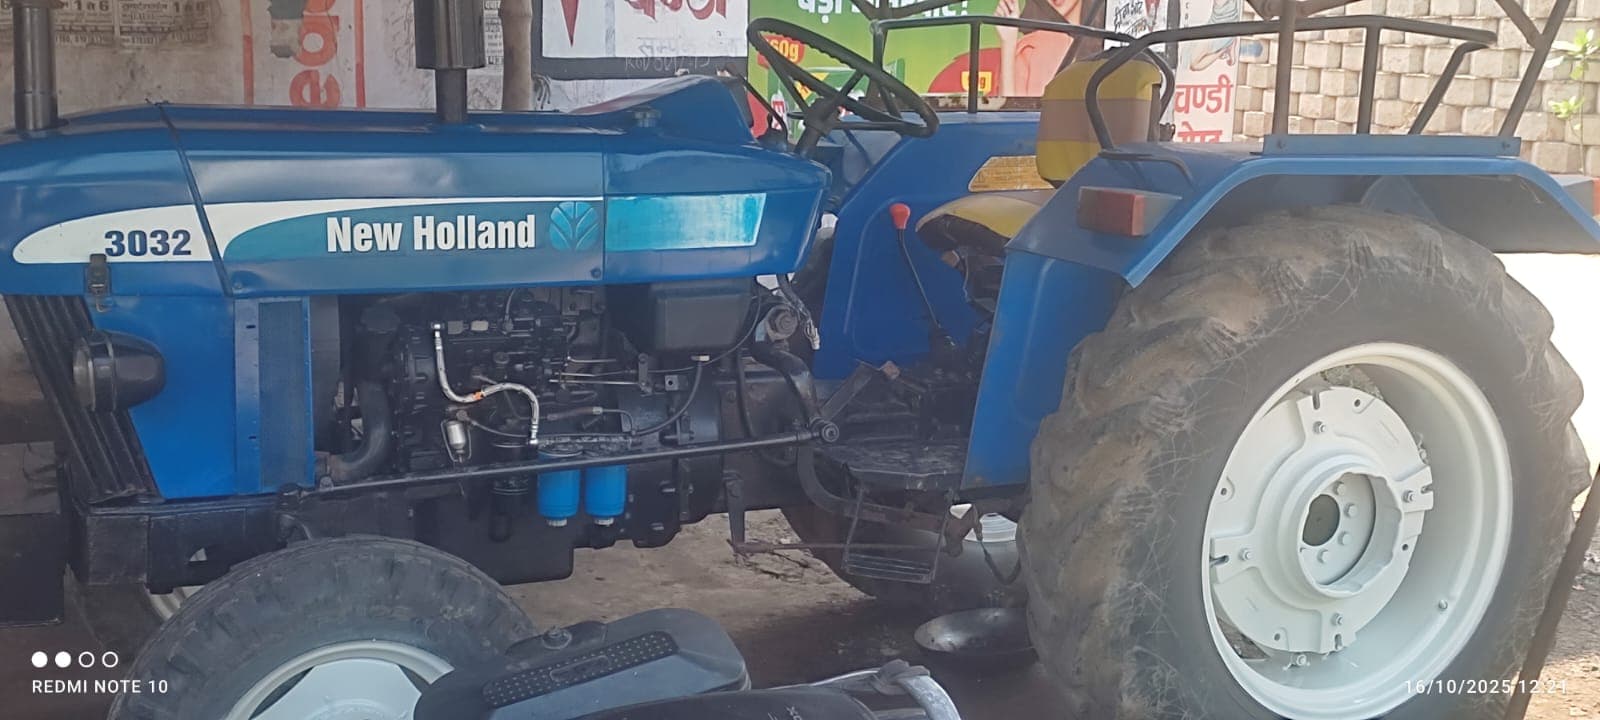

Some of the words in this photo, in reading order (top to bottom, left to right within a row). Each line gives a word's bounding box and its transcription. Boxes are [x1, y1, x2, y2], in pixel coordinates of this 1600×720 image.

[1174, 74, 1234, 114] चण्डी
[104, 230, 191, 257] 3032
[326, 217, 403, 253] New
[413, 215, 536, 251] Holland
